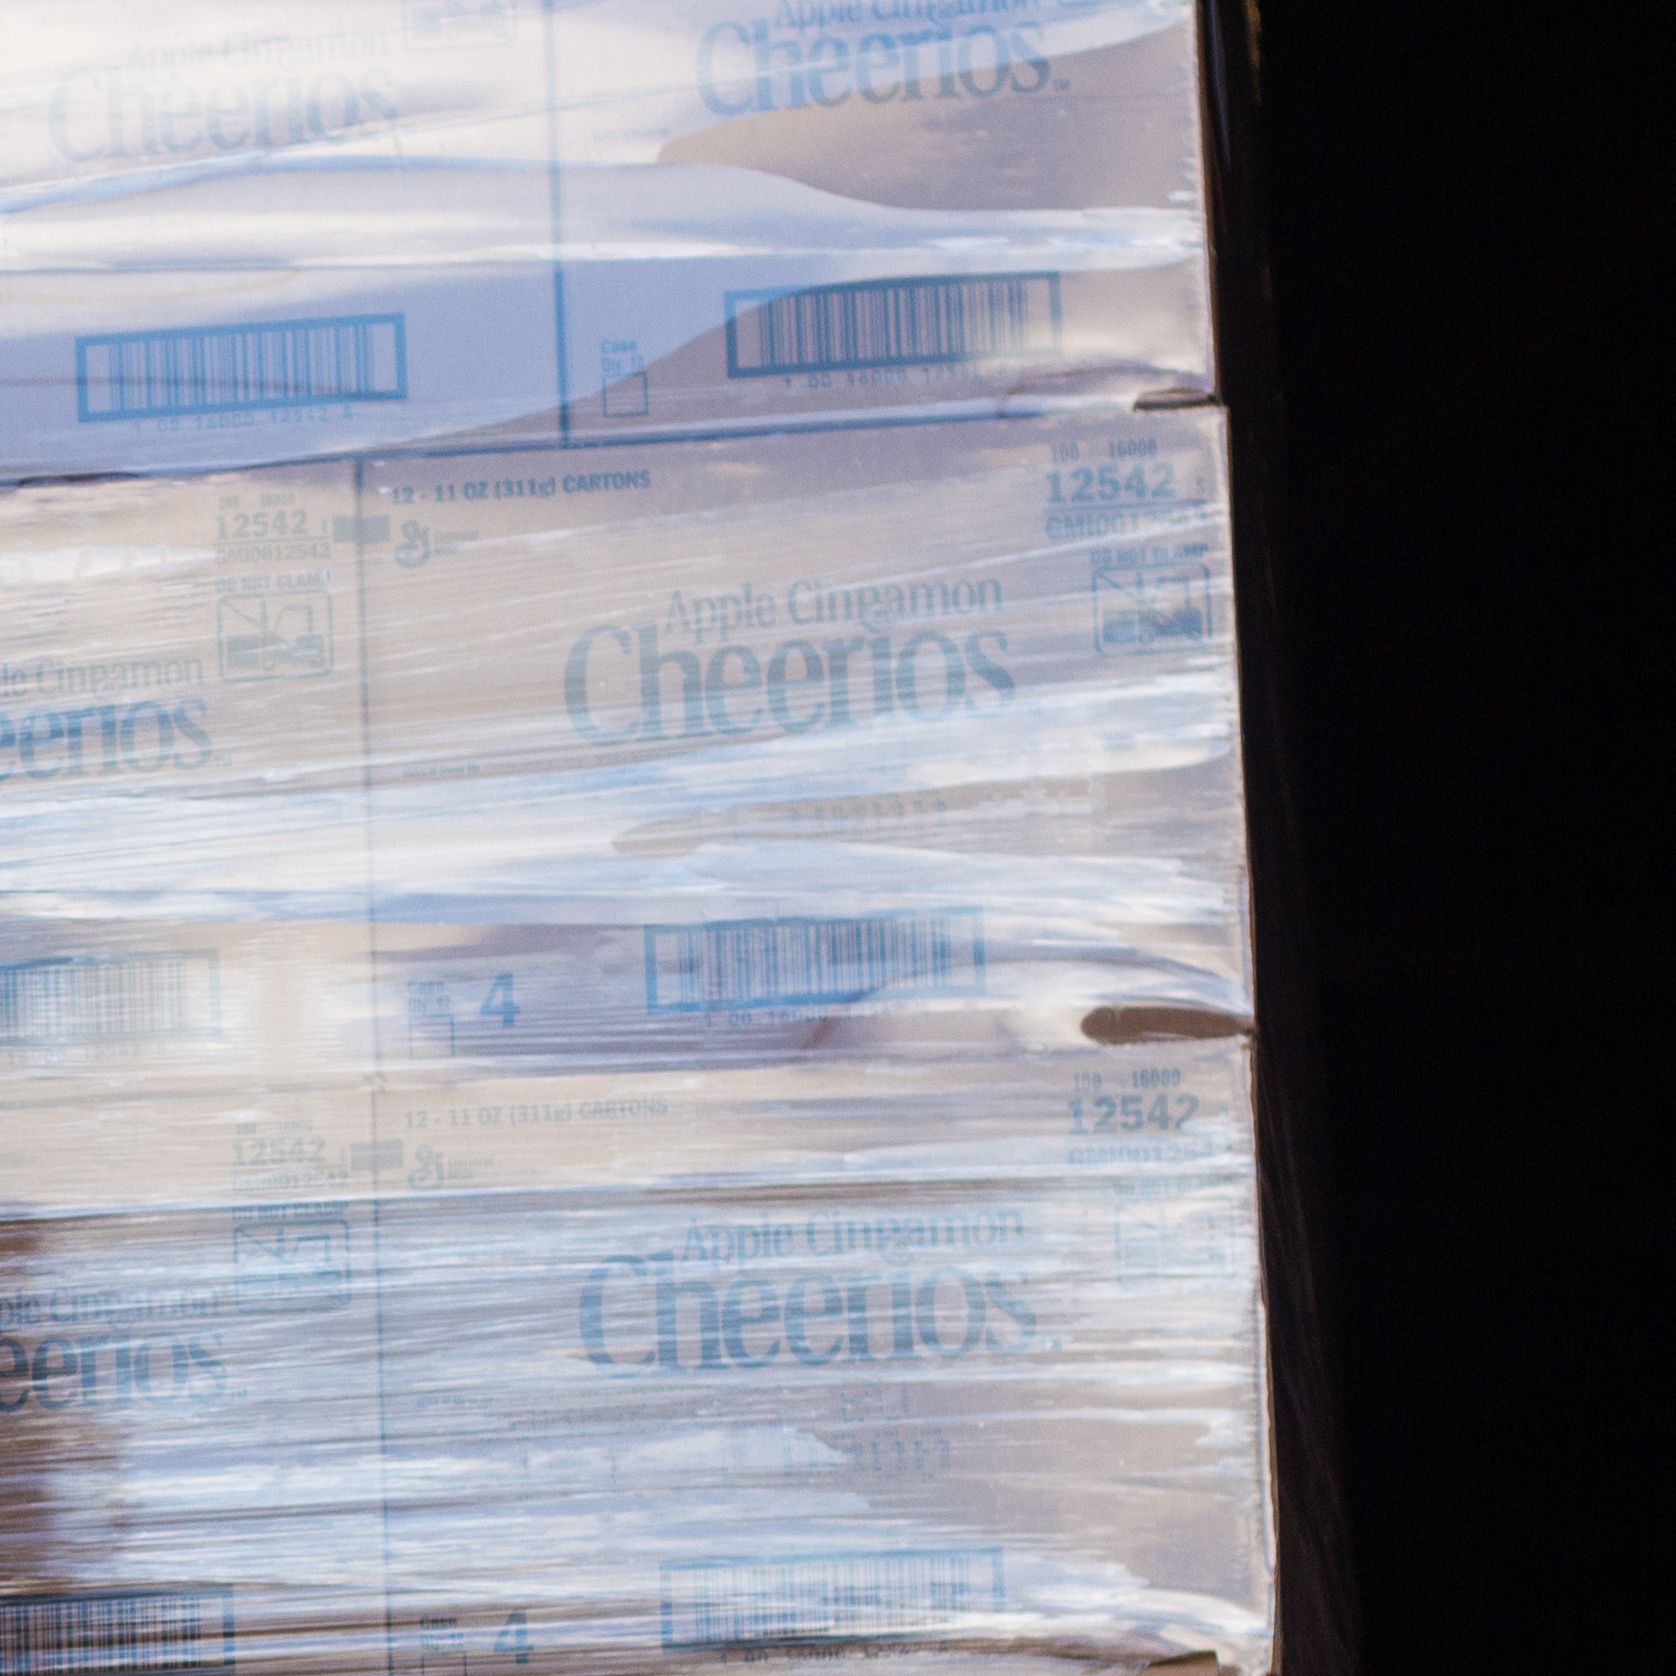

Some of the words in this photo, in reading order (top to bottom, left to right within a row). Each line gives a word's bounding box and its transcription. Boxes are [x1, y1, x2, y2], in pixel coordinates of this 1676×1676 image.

[695, 21, 1050, 118] Cheerios
[1045, 464, 1175, 505] 12542
[214, 509, 310, 540] 12542
[663, 586, 779, 645] Apple
[787, 577, 1004, 636] Cinnamon
[561, 622, 1018, 749] Cheerios
[479, 972, 521, 1028] 4
[1066, 1093, 1201, 1136] 12542
[680, 1214, 794, 1269] Apple
[578, 1252, 1038, 1372] Cheerios
